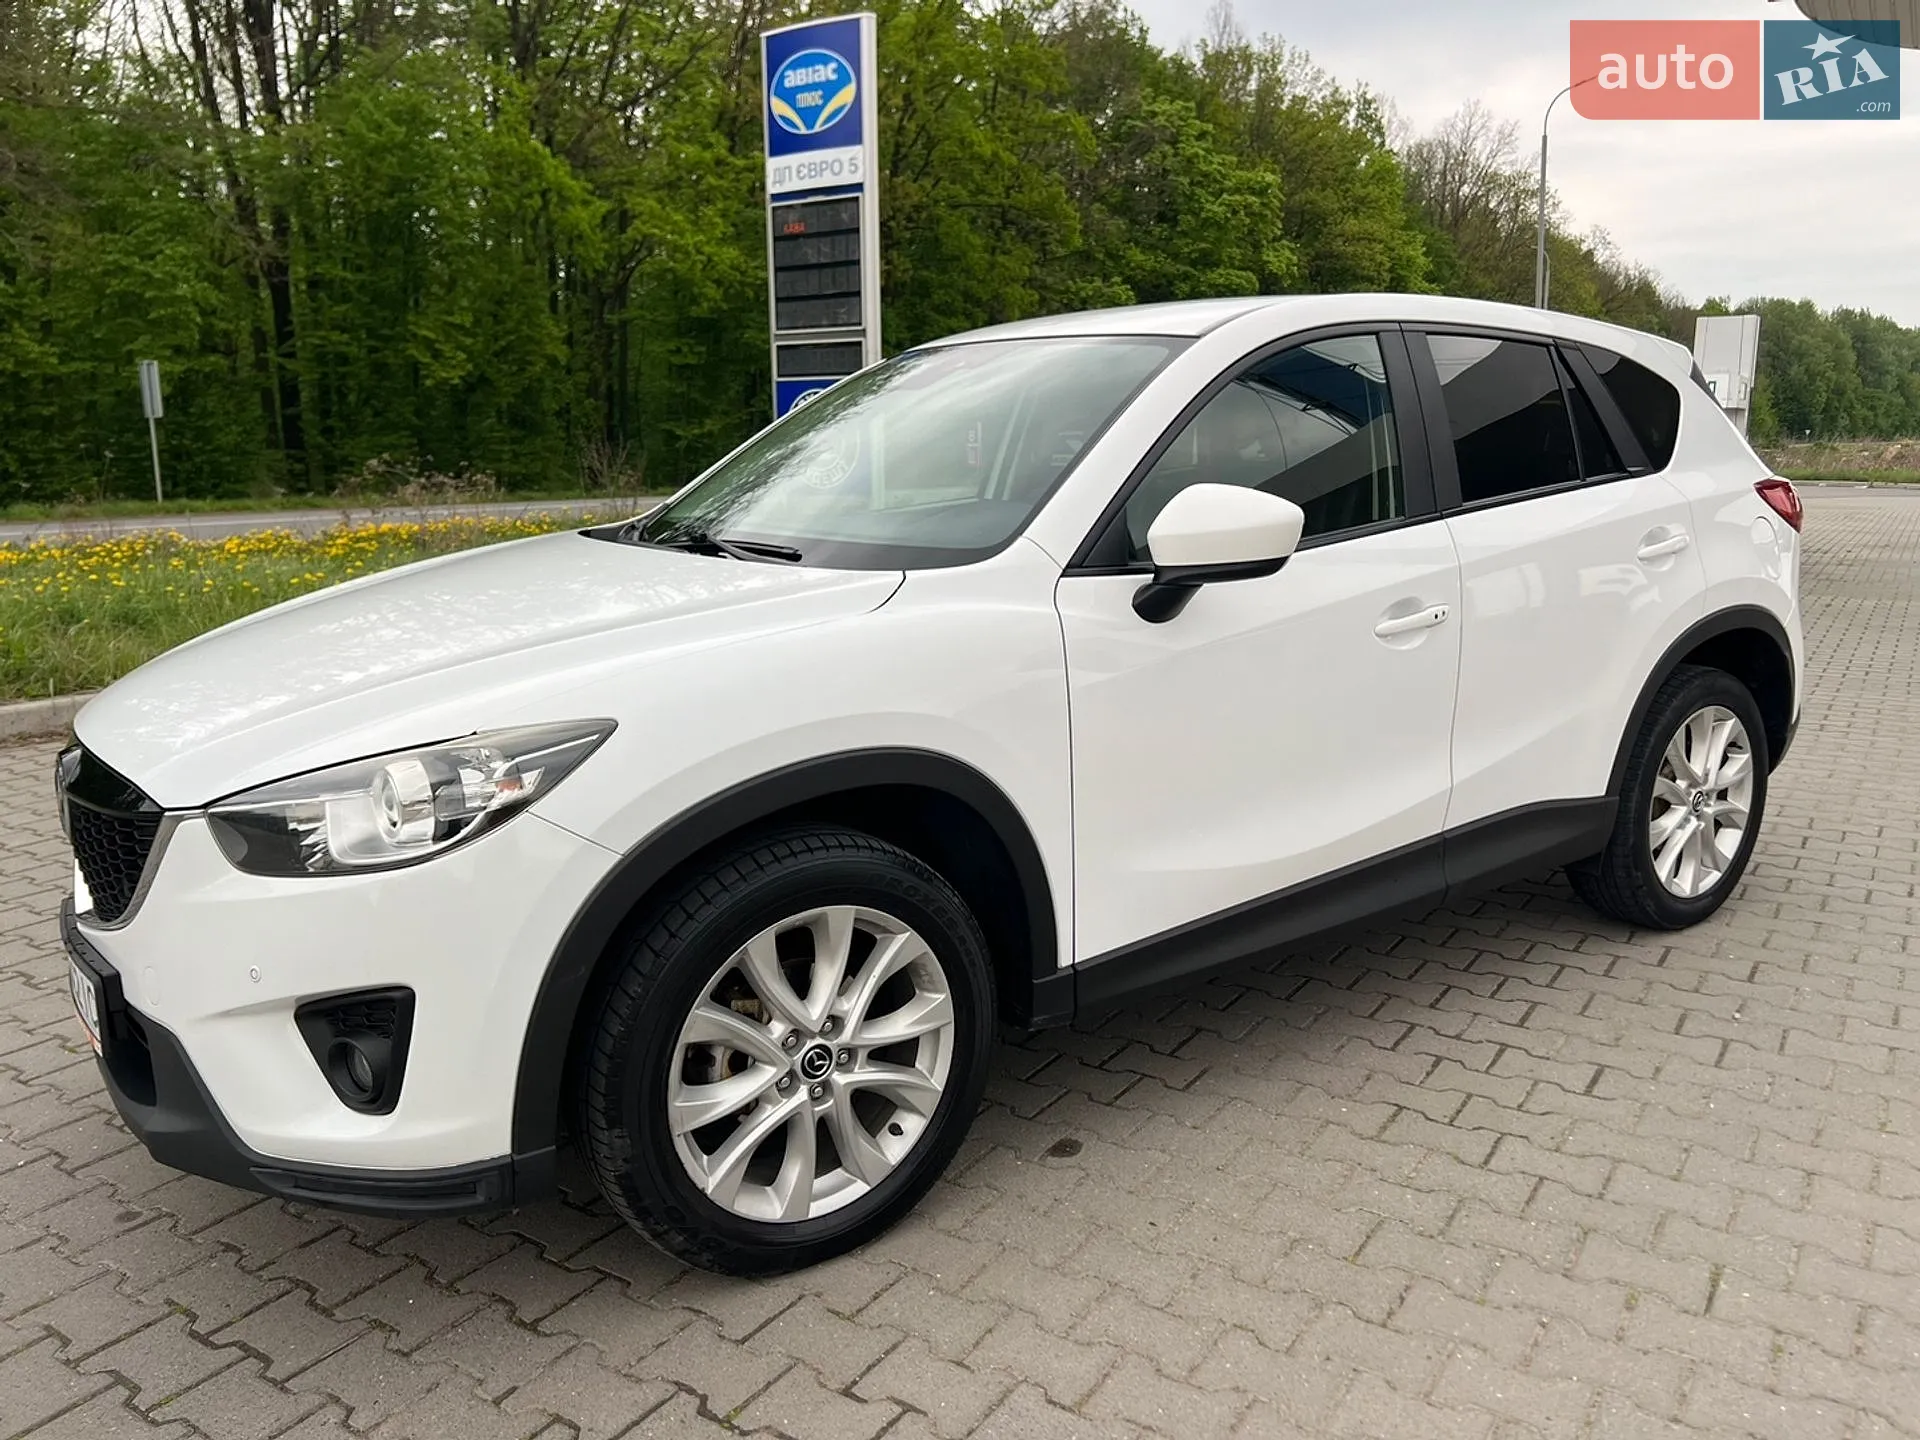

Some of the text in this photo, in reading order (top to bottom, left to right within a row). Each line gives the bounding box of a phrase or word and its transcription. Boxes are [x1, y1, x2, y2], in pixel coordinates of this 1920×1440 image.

[772, 156, 859, 188] ДП ЄВРО 5
